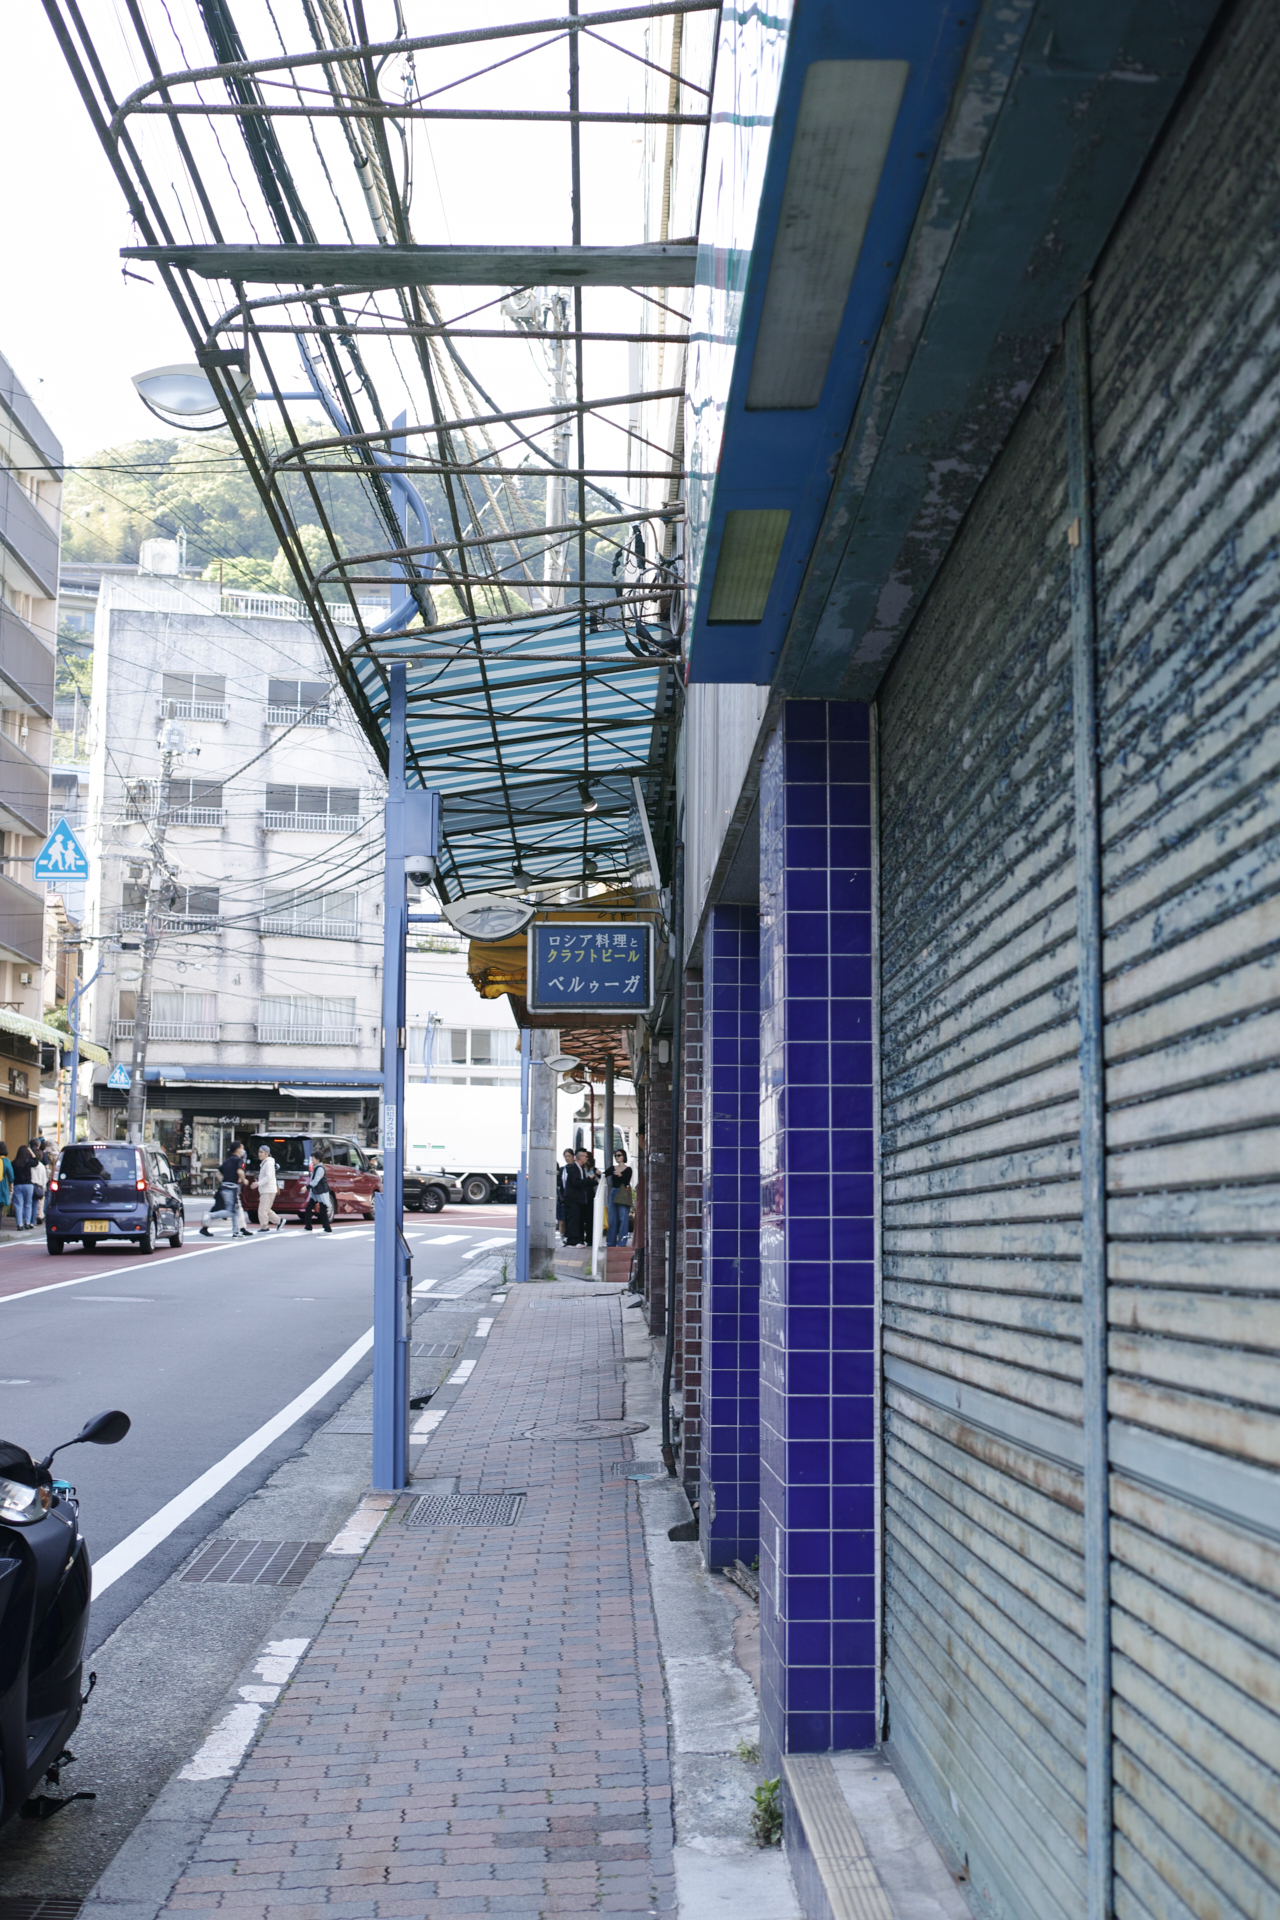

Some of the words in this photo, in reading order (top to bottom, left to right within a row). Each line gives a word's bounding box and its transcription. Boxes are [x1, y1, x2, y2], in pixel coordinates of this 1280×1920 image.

[548, 933, 638, 948] ロシア料理と
[547, 948, 640, 963] クラフトビール
[548, 975, 641, 994] ベルゥーガ
[386, 1106, 395, 1147] 防犯カメラ作動中
